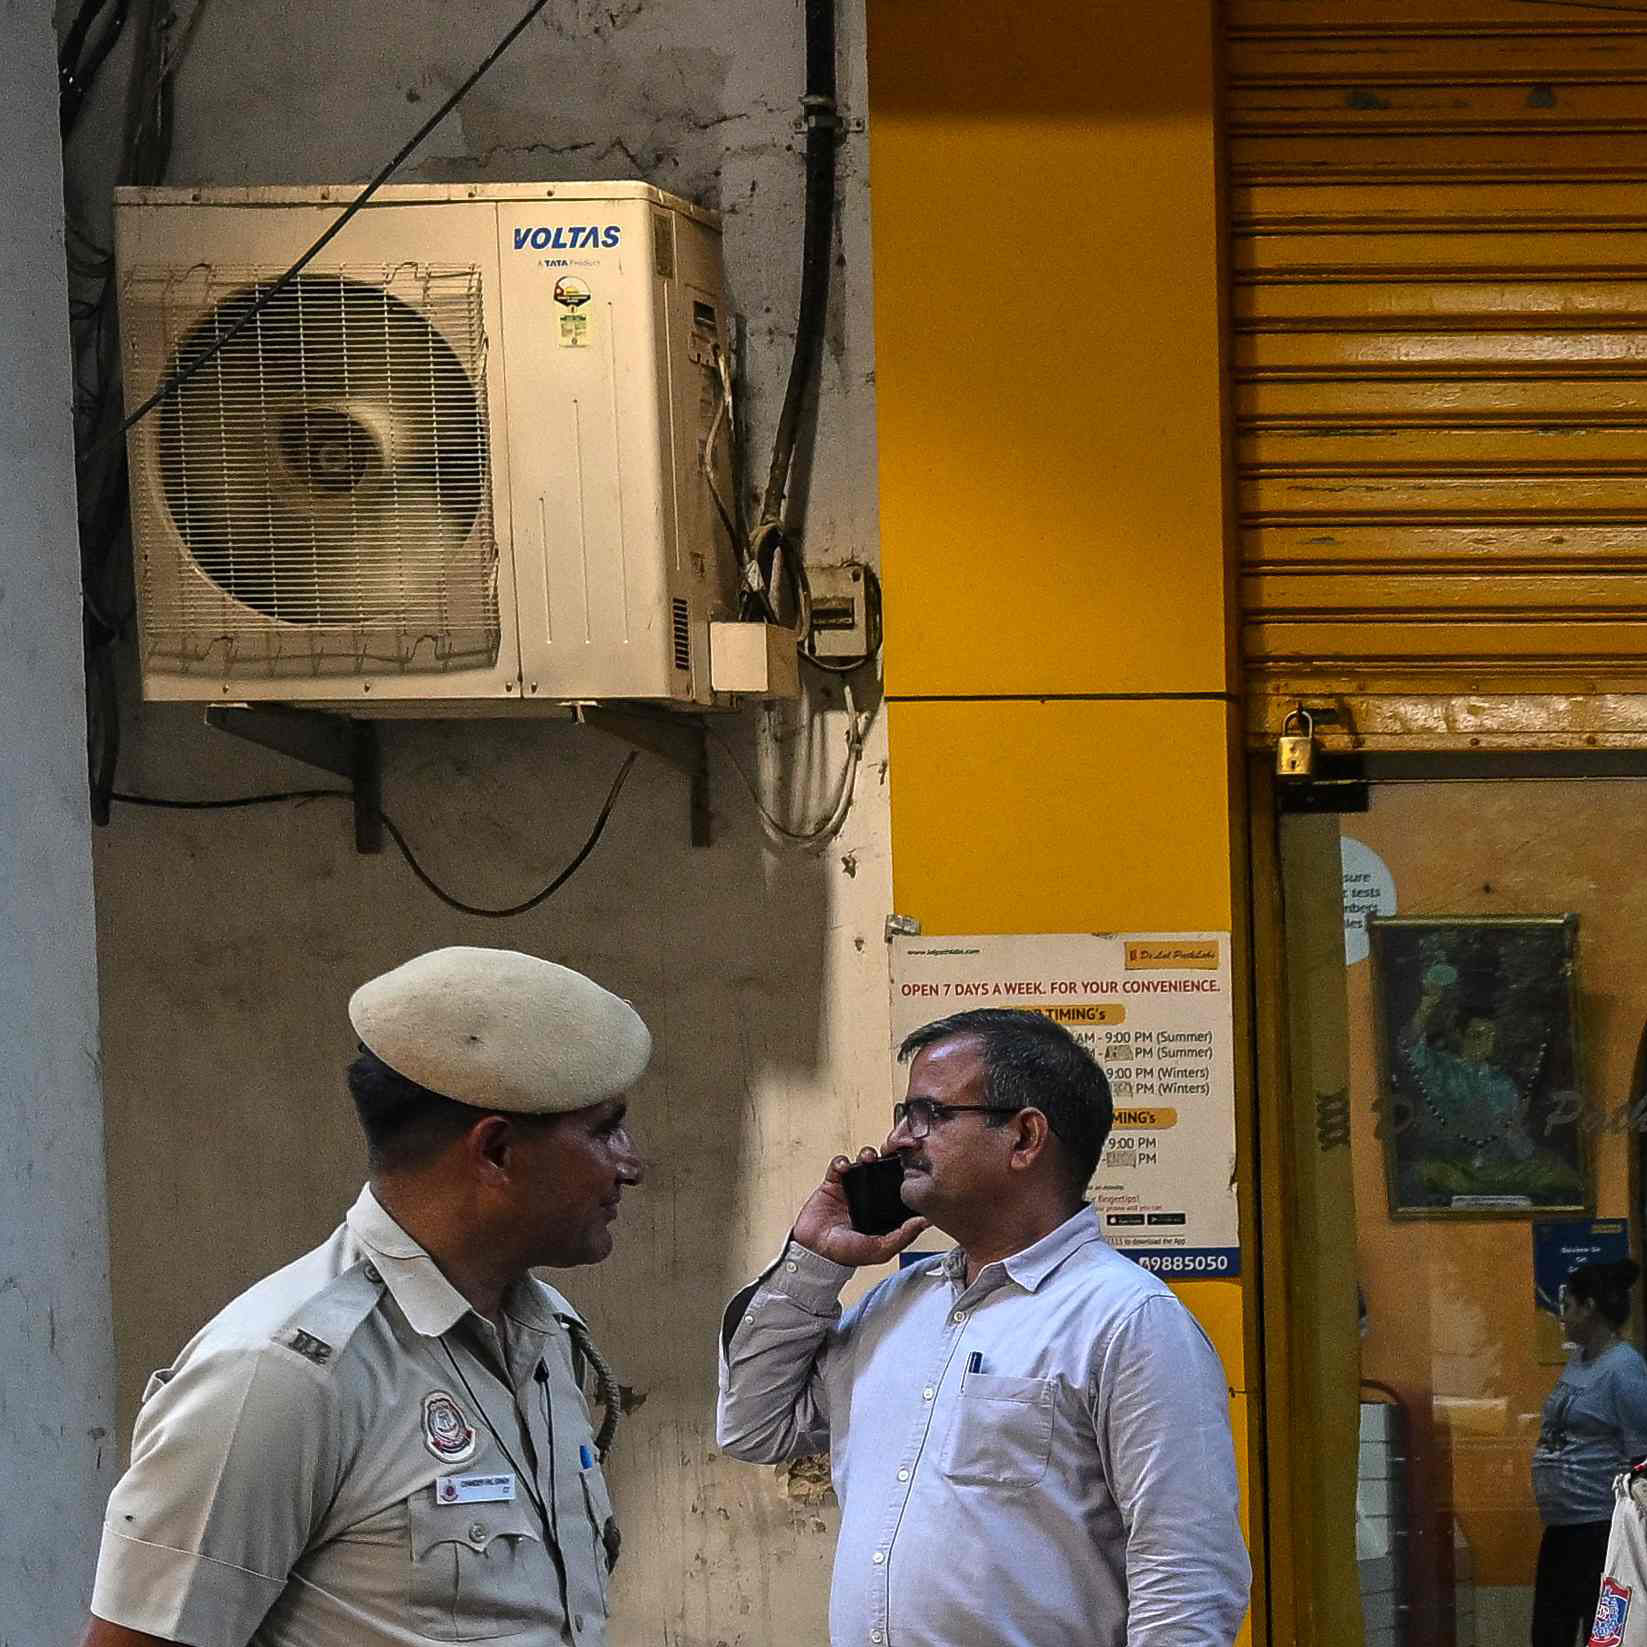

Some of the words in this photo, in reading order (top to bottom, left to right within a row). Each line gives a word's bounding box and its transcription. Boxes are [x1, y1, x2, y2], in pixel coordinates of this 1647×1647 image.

[513, 226, 621, 250] VOLTAS
[901, 983, 939, 997] OPEN
[943, 983, 951, 996] 7
[954, 982, 989, 996] DAYS
[992, 983, 1002, 995] A
[1003, 982, 1047, 995] WEEK.
[1050, 981, 1077, 994] FOR
[1081, 981, 1119, 994] YOUR
[1122, 979, 1221, 993] CONVENIENCE.
[1105, 1032, 1131, 1044] 9:00
[1134, 1031, 1153, 1043] PM
[1156, 1030, 1213, 1045] (Summer)
[1135, 1047, 1153, 1059] PM
[1157, 1046, 1213, 1060] (Summer)
[1107, 1067, 1132, 1080] 9:00
[1136, 1067, 1154, 1079] PM
[1157, 1066, 1210, 1081] (Winters)
[1136, 1083, 1154, 1094] PM
[1158, 1081, 1211, 1097] (Winters)
[1113, 1111, 1157, 1124] MING's
[1108, 1137, 1134, 1149] 9:00
[1138, 1137, 1157, 1149] PM
[1138, 1152, 1157, 1164] PM
